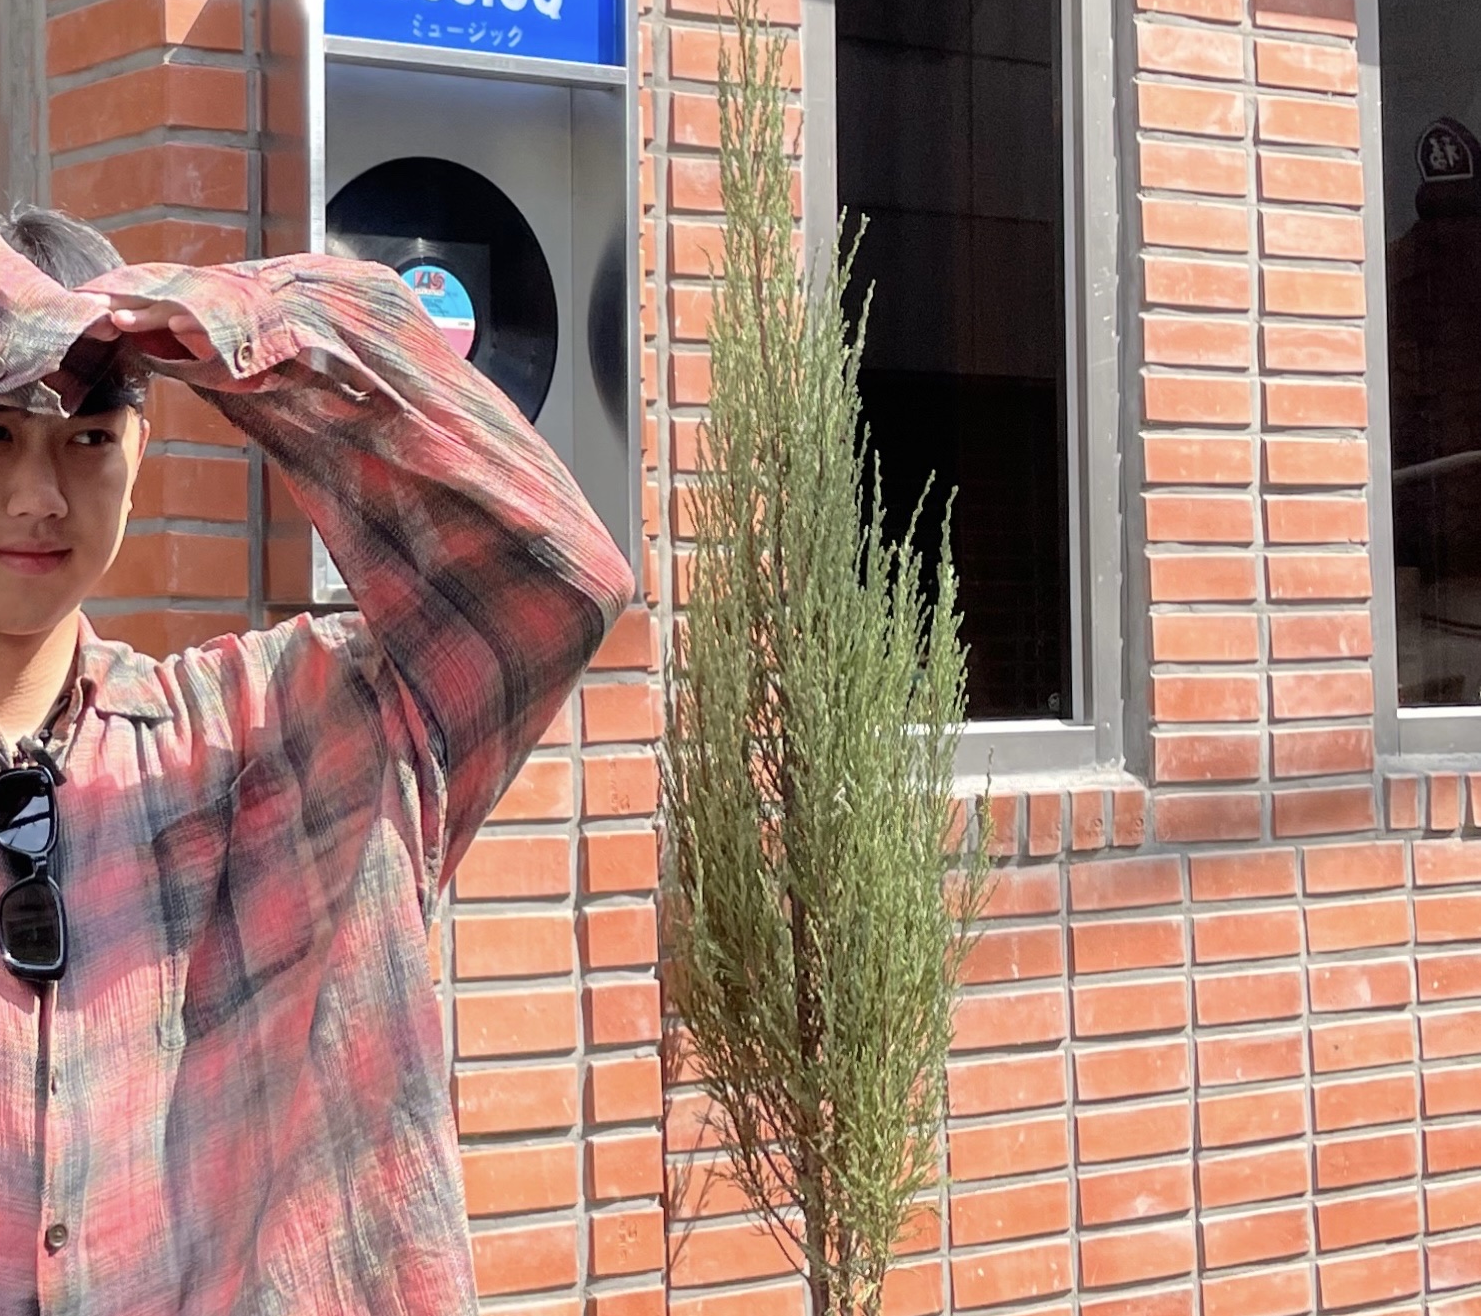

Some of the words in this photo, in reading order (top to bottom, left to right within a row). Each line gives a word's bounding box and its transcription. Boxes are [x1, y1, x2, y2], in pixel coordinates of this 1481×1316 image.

[412, 14, 523, 48] ミュージック
